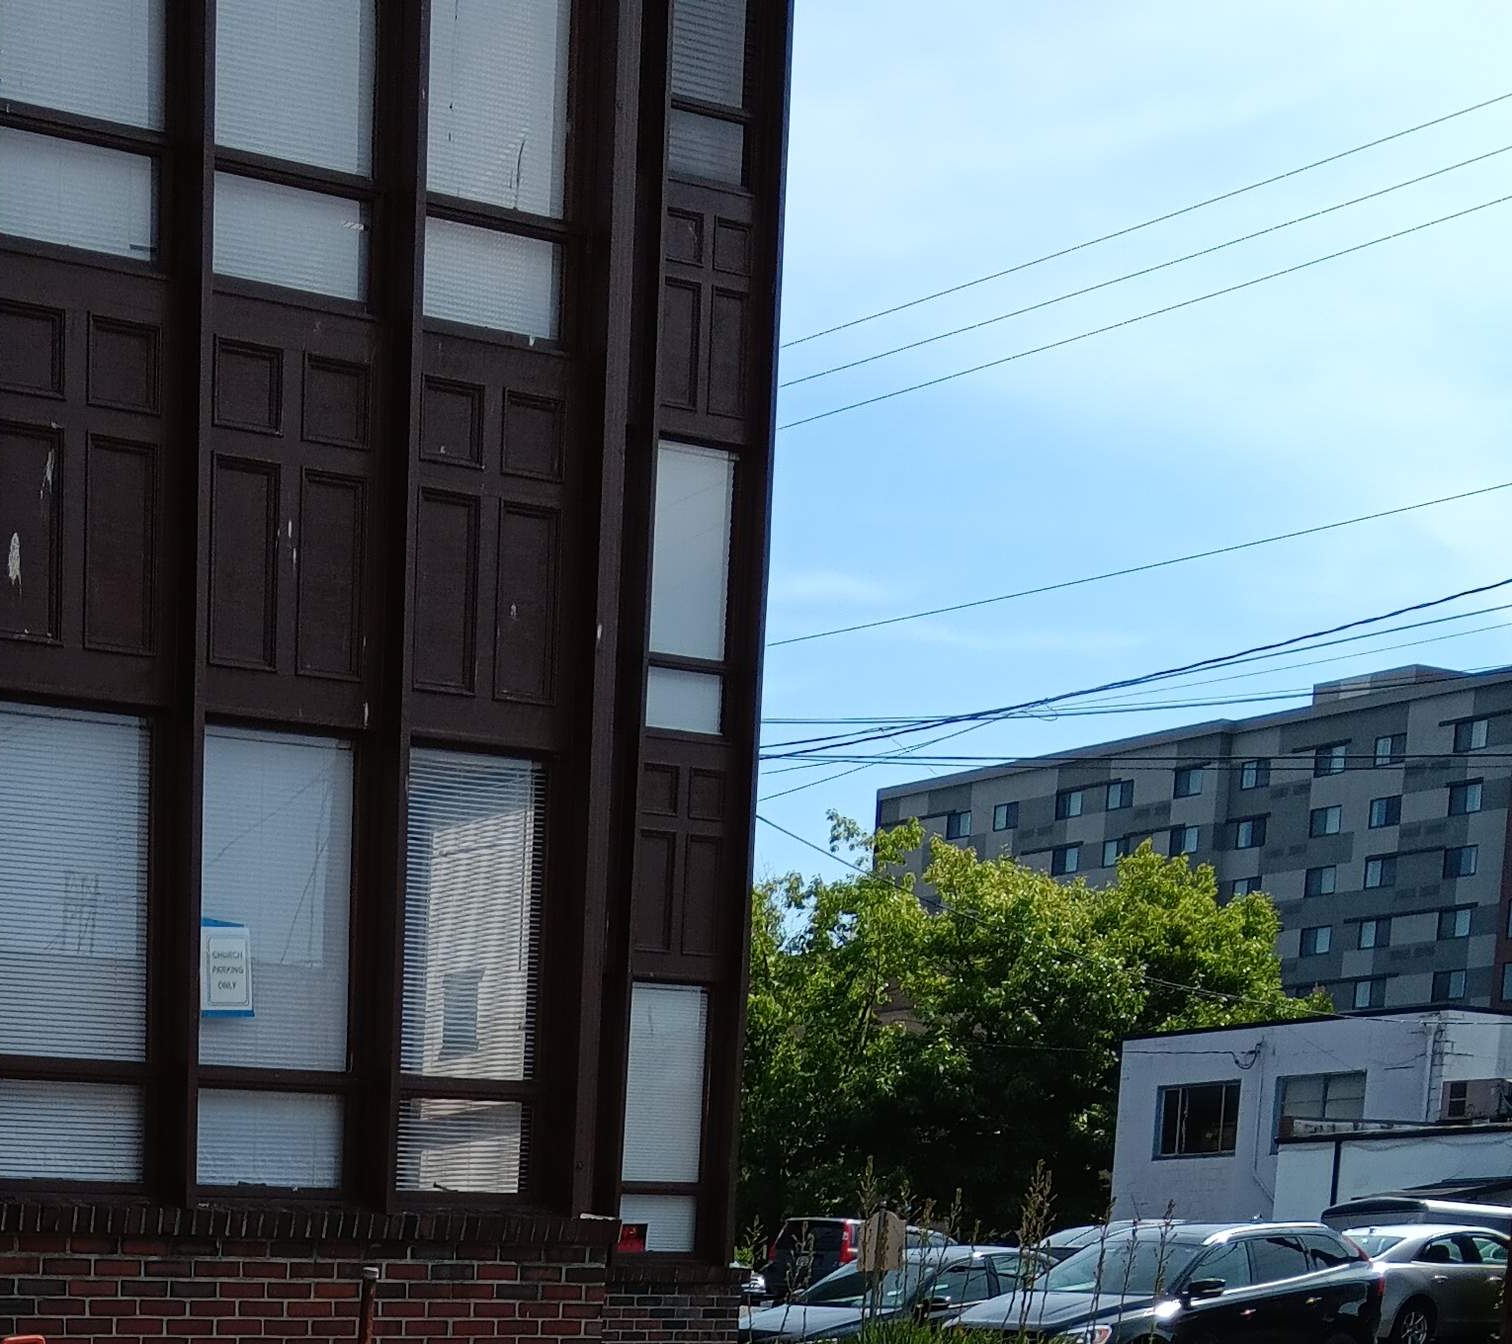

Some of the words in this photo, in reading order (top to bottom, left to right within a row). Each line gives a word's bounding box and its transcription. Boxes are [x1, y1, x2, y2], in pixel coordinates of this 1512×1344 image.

[211, 951, 243, 960] CHURCH
[211, 965, 244, 975] PARKING
[217, 981, 237, 991] ONLY
